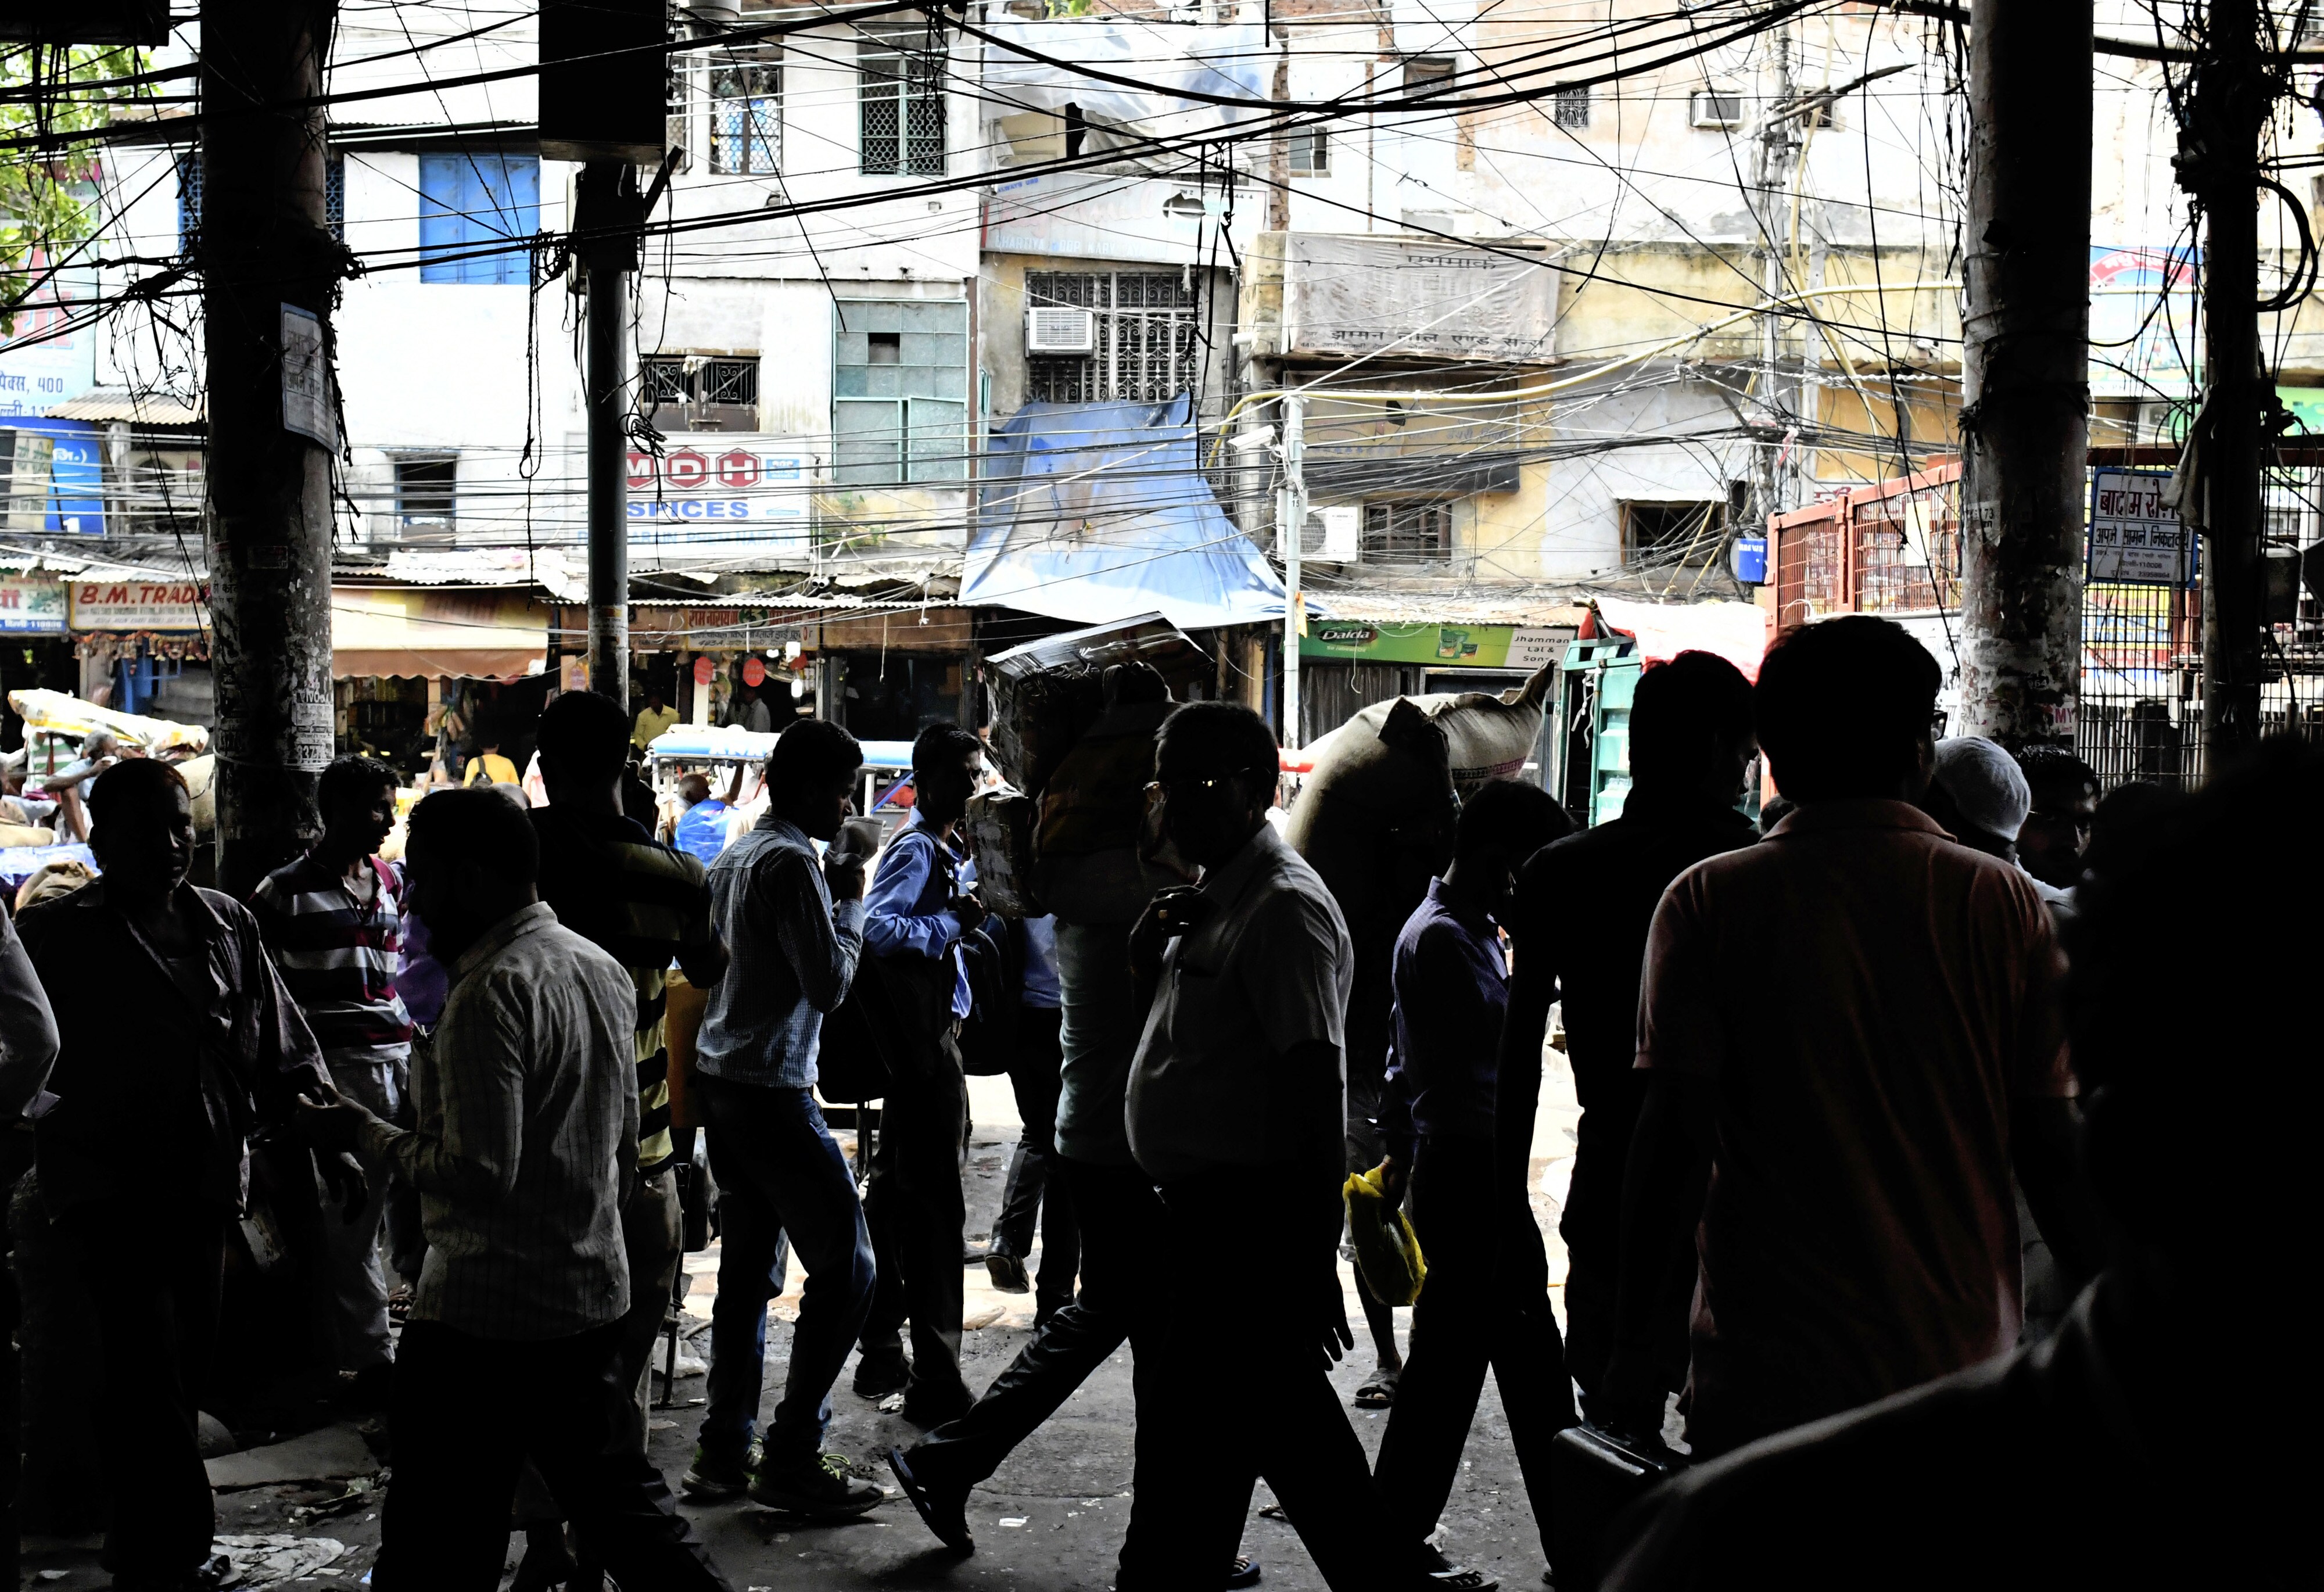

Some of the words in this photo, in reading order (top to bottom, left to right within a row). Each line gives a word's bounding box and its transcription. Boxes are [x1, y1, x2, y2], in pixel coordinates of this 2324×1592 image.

[1330, 330, 1384, 340] झम्मन
[1451, 335, 1489, 346] एण्ड
[38, 377, 63, 393] 400
[627, 458, 755, 482] MDH
[627, 501, 749, 518] SPICES
[2100, 489, 2143, 517] बादम
[2096, 525, 2117, 544] अपने
[688, 610, 706, 628] राम
[1321, 629, 1369, 641] Dalda
[1513, 635, 1570, 645] Jhamman
